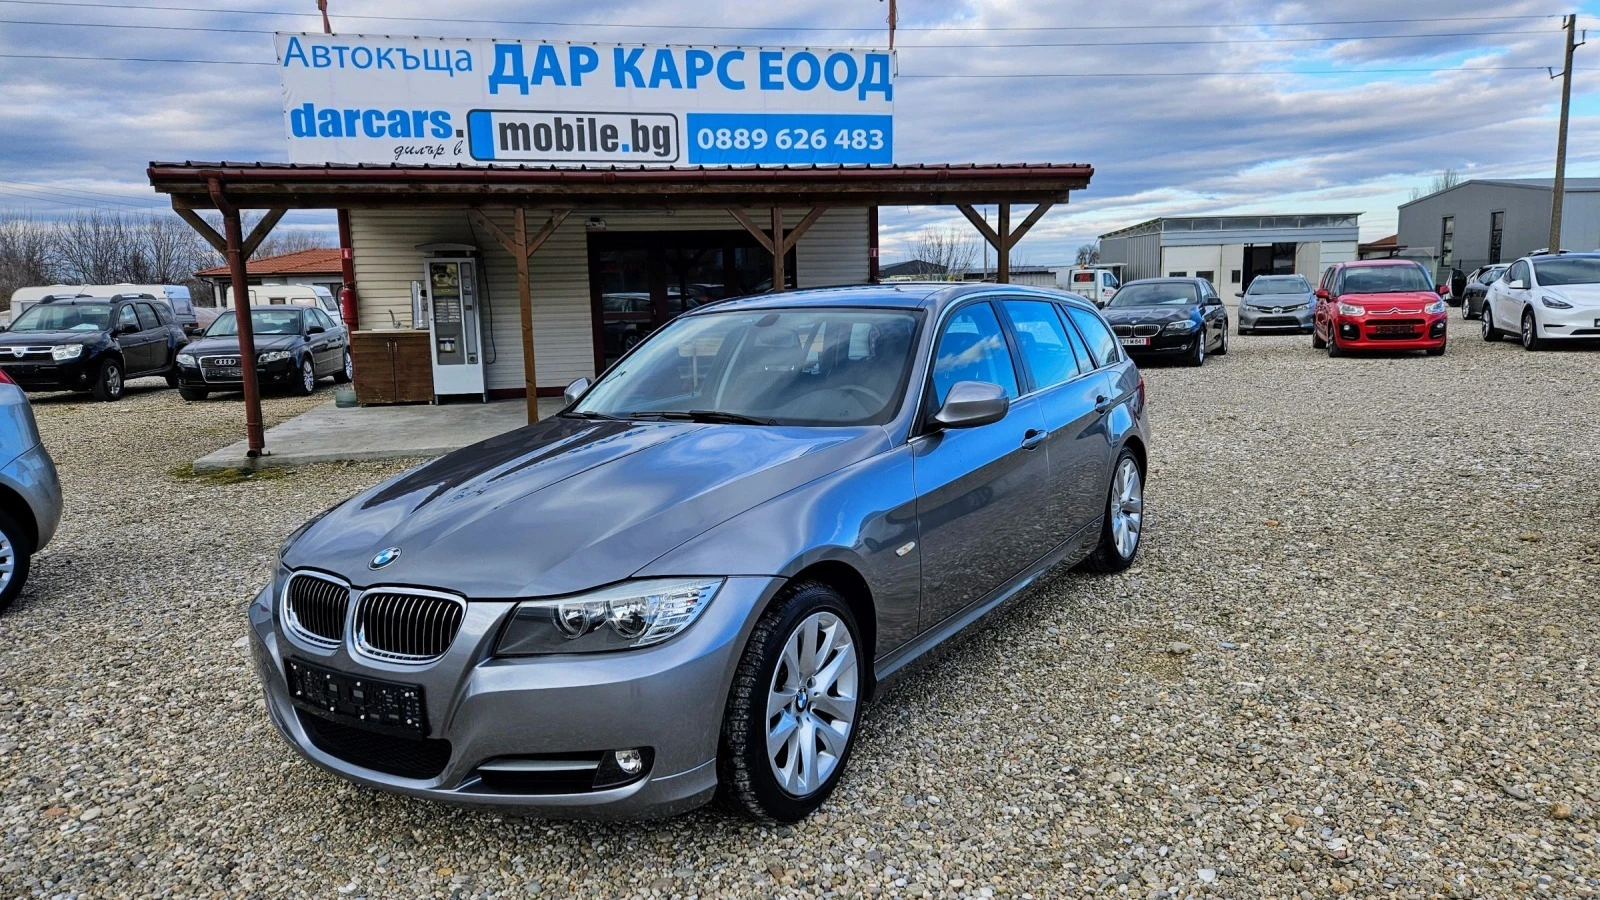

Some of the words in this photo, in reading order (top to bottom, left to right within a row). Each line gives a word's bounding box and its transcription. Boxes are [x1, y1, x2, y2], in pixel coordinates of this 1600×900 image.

[284, 36, 473, 77] Автокъща
[488, 43, 599, 95] ДАР
[613, 47, 746, 90] КАРС
[759, 51, 893, 101] ЕООД
[394, 144, 446, 160] дилър
[498, 117, 671, 157] mobile.bg
[697, 128, 768, 150] 0889
[775, 128, 827, 150] 626
[833, 129, 884, 150] 483
